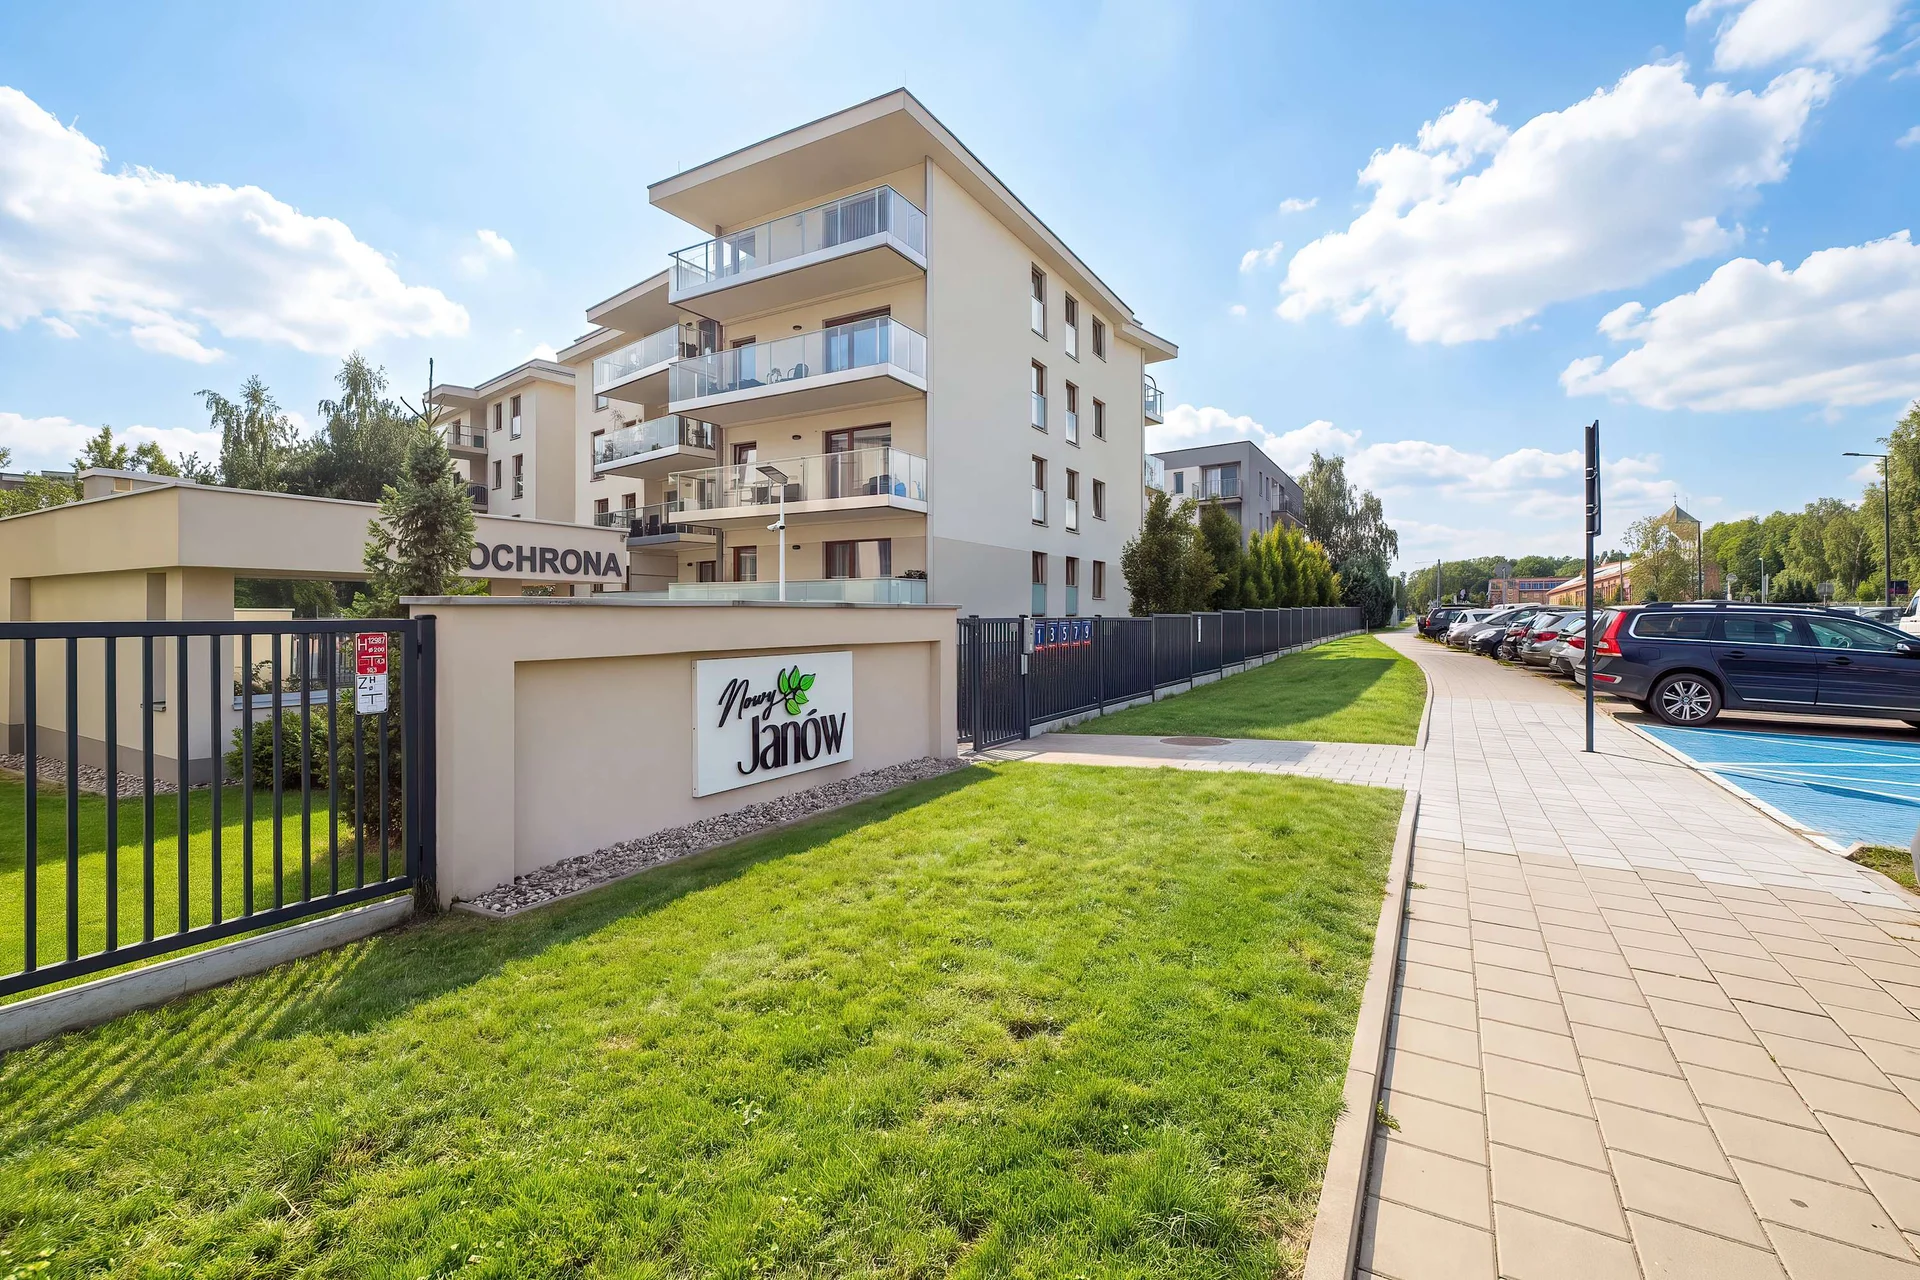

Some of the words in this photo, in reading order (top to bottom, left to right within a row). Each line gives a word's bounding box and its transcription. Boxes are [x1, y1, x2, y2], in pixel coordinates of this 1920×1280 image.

[469, 542, 622, 577] OCHRONA
[1037, 628, 1041, 643] 1
[1050, 627, 1055, 641] 3
[1062, 626, 1067, 640] 5
[1074, 626, 1078, 639] 7
[1085, 626, 1089, 638] 9
[358, 638, 367, 651] H
[718, 678, 777, 728] Nowy
[737, 708, 846, 775] Janów
